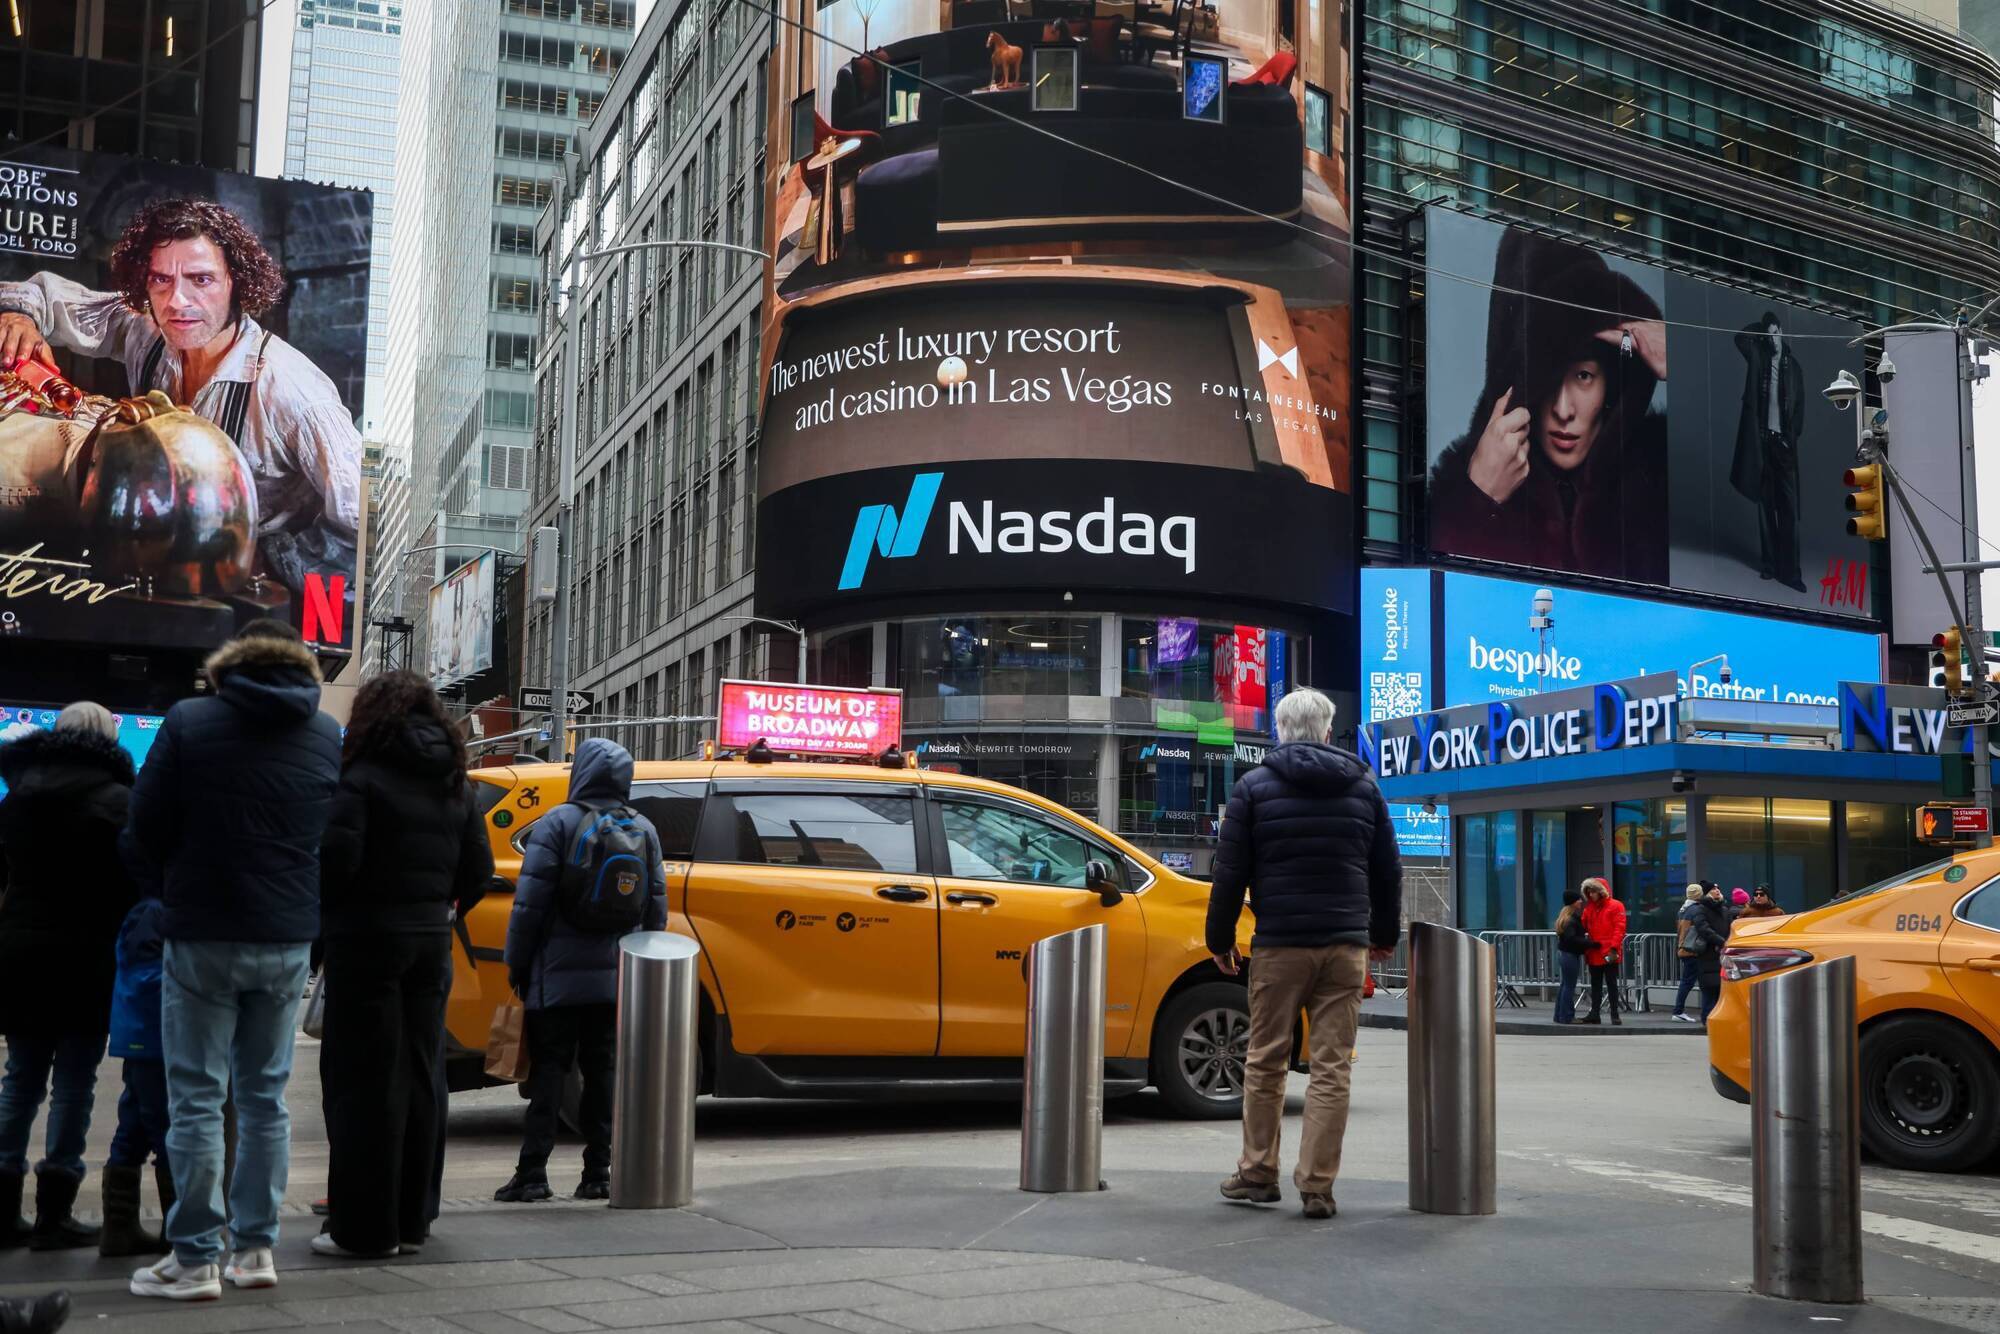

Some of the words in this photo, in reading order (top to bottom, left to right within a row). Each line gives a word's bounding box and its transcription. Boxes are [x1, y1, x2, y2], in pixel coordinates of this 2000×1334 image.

[0, 234, 25, 247] DEL
[32, 238, 77, 253] TORO
[771, 361, 798, 396] The
[801, 333, 890, 382] newest
[899, 328, 997, 364] luxury
[1007, 322, 1121, 353] resort
[795, 388, 834, 431] and
[840, 380, 938, 418] casino
[948, 378, 977, 405] in
[989, 369, 1051, 403] Las
[1060, 367, 1172, 413] Vegas
[1201, 383, 1337, 421] FONTAINEBLEAU
[1235, 410, 1262, 423] LAS
[1273, 416, 1317, 434] VEGAS
[949, 497, 1196, 574] Nasdaq
[1819, 558, 1869, 611] H&M
[1382, 587, 1401, 661] bespoke
[1469, 635, 1581, 682] bespoke
[1488, 683, 1526, 697] Physical
[566, 698, 583, 708] AY
[749, 692, 841, 716] MUSEUM
[847, 699, 877, 717] OF
[1951, 711, 1967, 721] ONE
[1975, 707, 1992, 718] WAY
[748, 714, 880, 738] BROADWAY
[1358, 722, 1414, 777] NEW
[1413, 713, 1483, 773] YORK
[1488, 701, 1586, 764] POLICE
[1594, 683, 1680, 751] DEPT
[1843, 684, 1948, 753] NEW
[808, 739, 823, 748] DAY
[825, 740, 835, 748] AT
[929, 744, 960, 754] Nasdaq
[975, 745, 1015, 753] REWRITE
[1019, 745, 1072, 753] TOMORROW
[1157, 748, 1190, 760] Nasdaq
[1166, 811, 1196, 821] Nasdaq
[995, 950, 1022, 960] NYC
